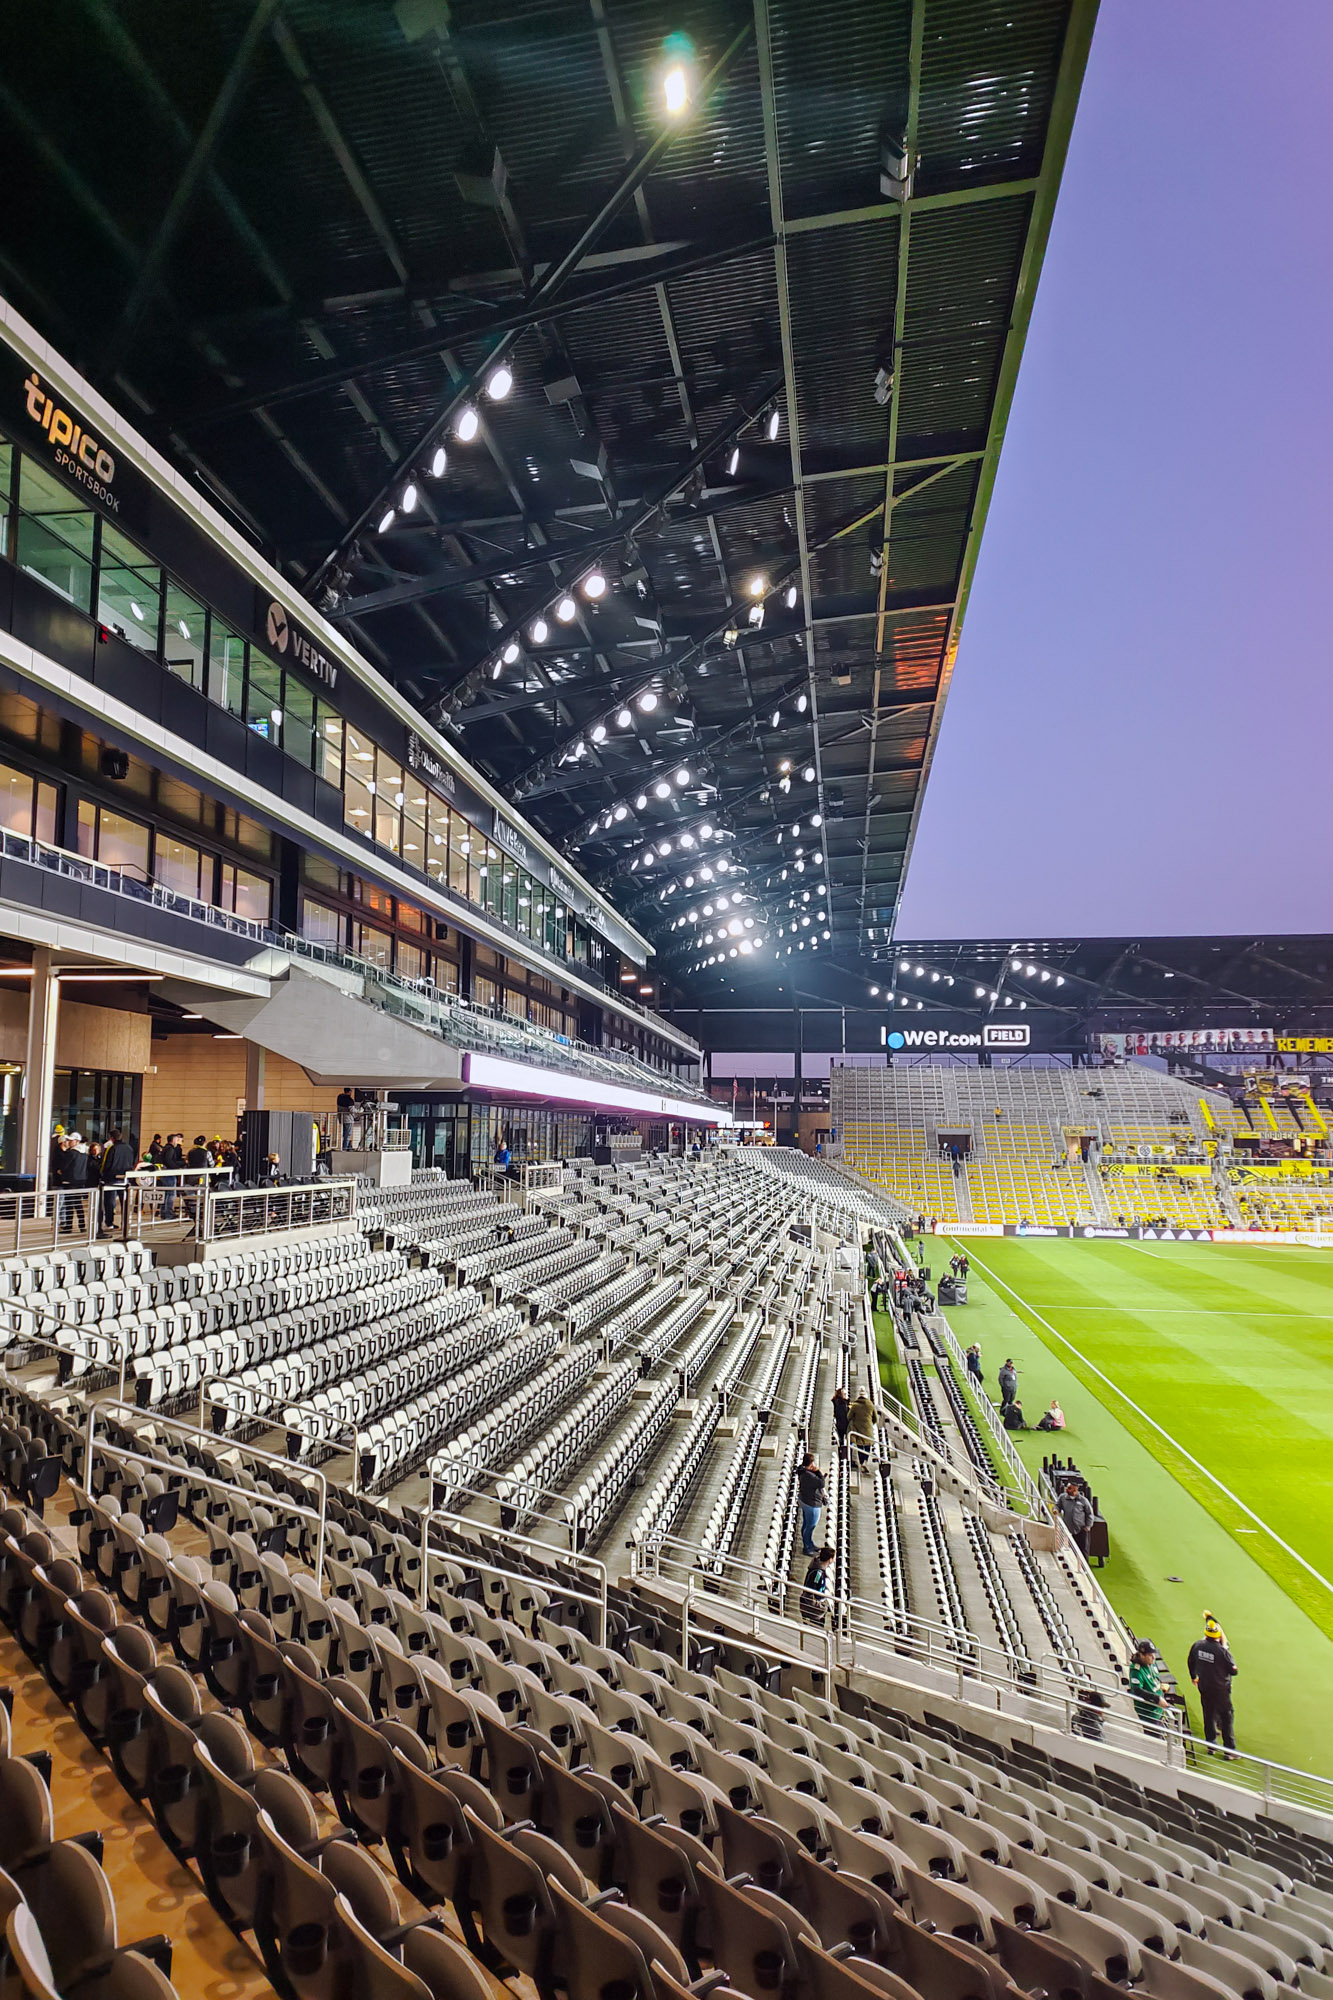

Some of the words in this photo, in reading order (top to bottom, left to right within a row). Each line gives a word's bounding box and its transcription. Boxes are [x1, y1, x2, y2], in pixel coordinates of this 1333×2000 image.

[24, 372, 116, 485] tipico
[54, 448, 121, 513] SPORTSBOOK
[291, 630, 338, 689] VERTIV
[990, 1030, 1024, 1041] FIELD
[151, 1193, 163, 1201] 112
